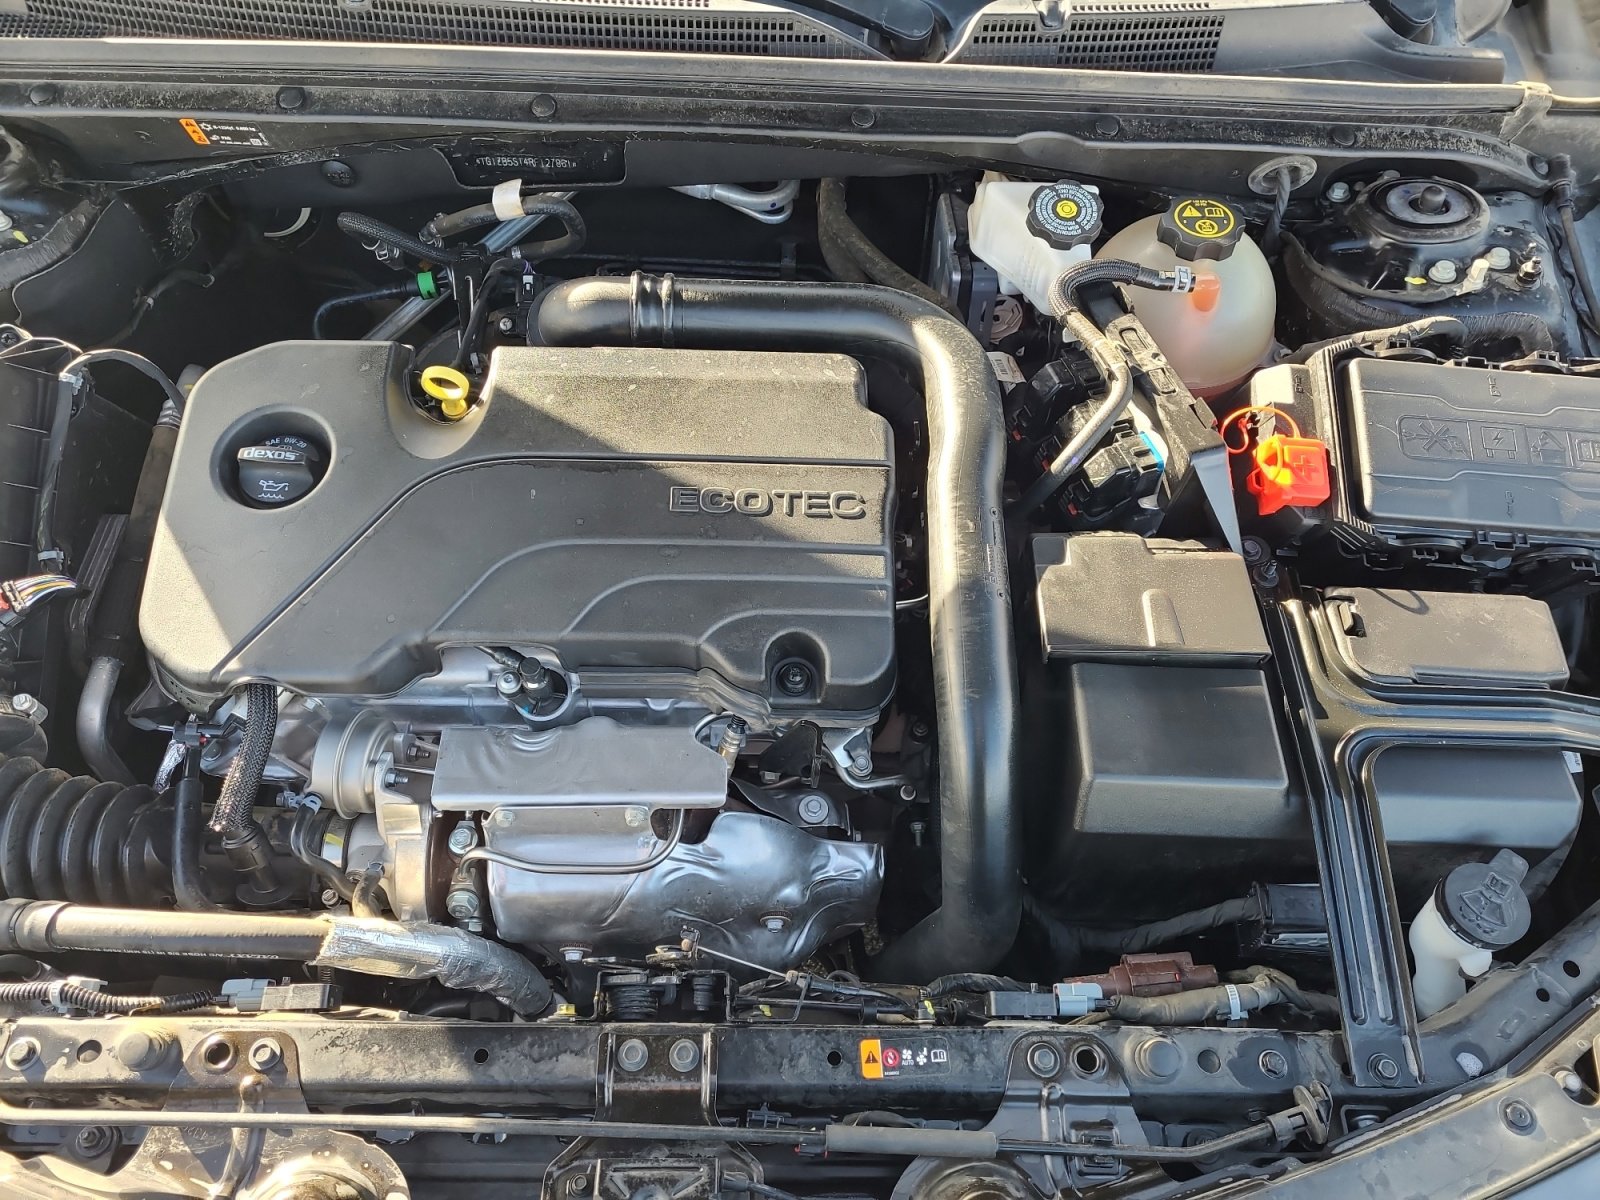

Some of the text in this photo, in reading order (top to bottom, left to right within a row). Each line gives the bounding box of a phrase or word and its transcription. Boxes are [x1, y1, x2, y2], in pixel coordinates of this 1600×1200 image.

[265, 437, 307, 449] SAE 0W-20
[243, 447, 300, 461] dexos
[669, 486, 867, 518] ECOTEC
